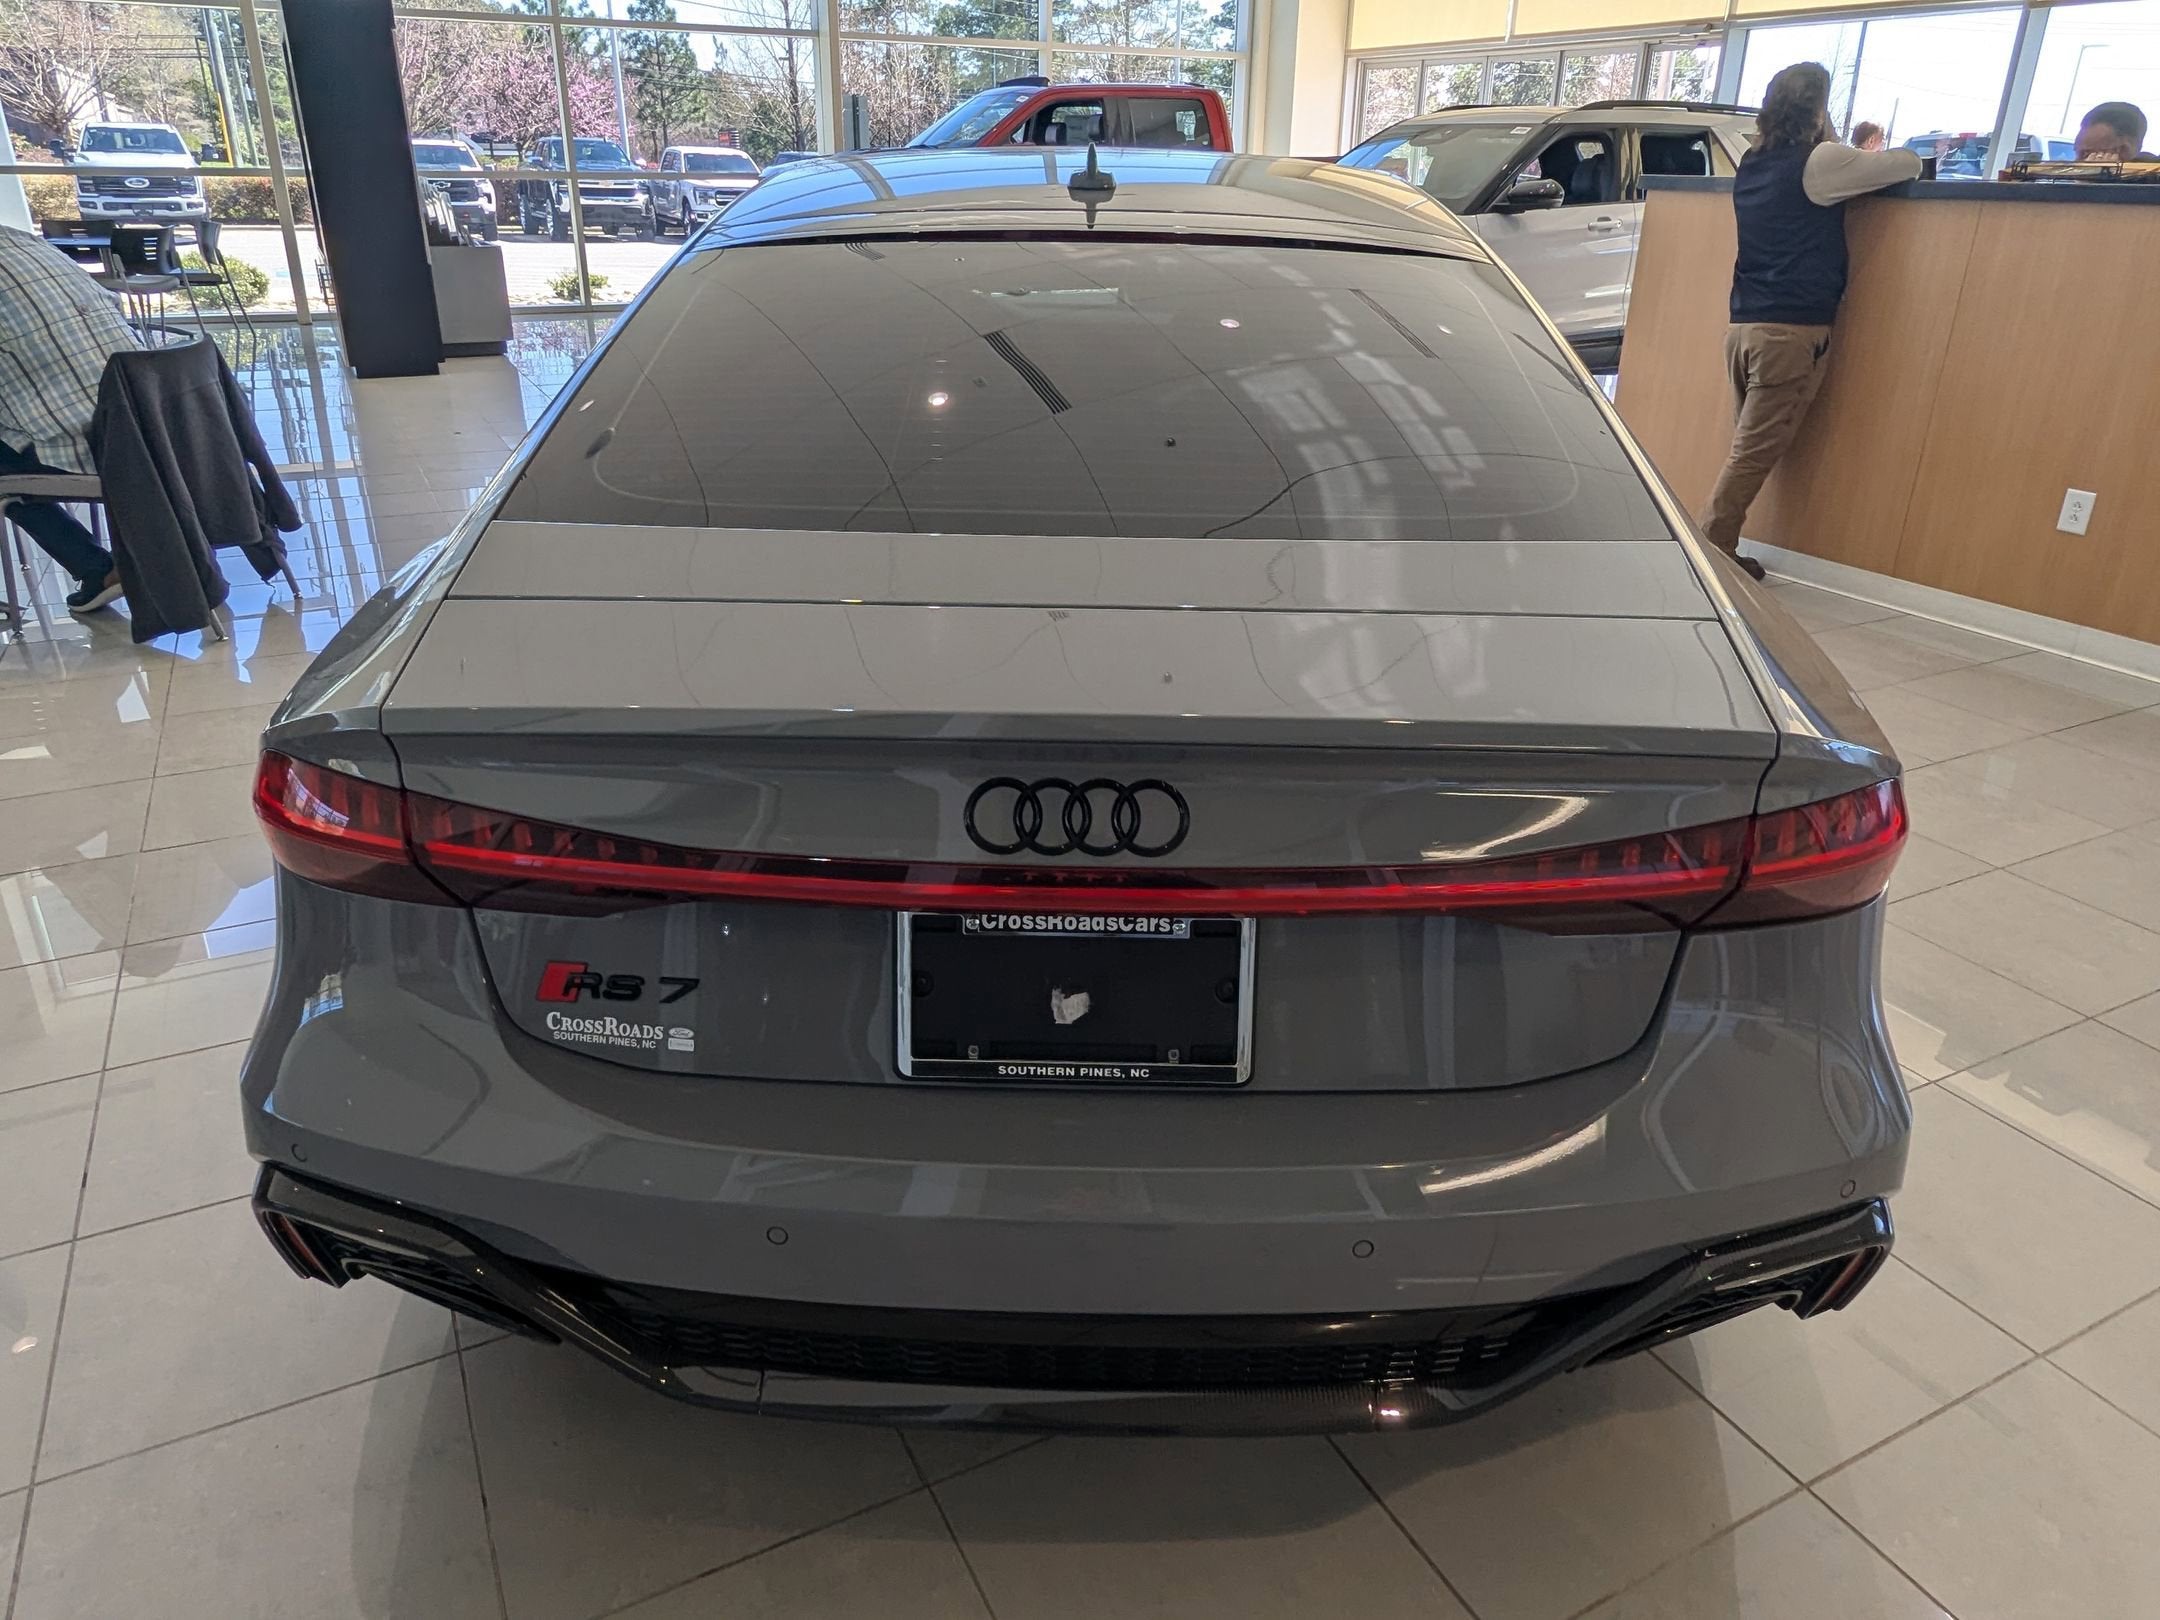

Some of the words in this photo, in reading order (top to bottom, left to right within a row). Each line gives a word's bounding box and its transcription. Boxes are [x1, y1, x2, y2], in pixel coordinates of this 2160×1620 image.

[561, 972, 645, 1001] RS
[658, 976, 700, 1004] 7
[553, 1030, 607, 1045] SOUTHERN
[608, 1036, 640, 1049] PINES,
[641, 1039, 657, 1049] NC
[998, 1065, 1075, 1077] SOUTHERN
[1080, 1067, 1125, 1079] PINES,
[1130, 1068, 1150, 1078] NC
